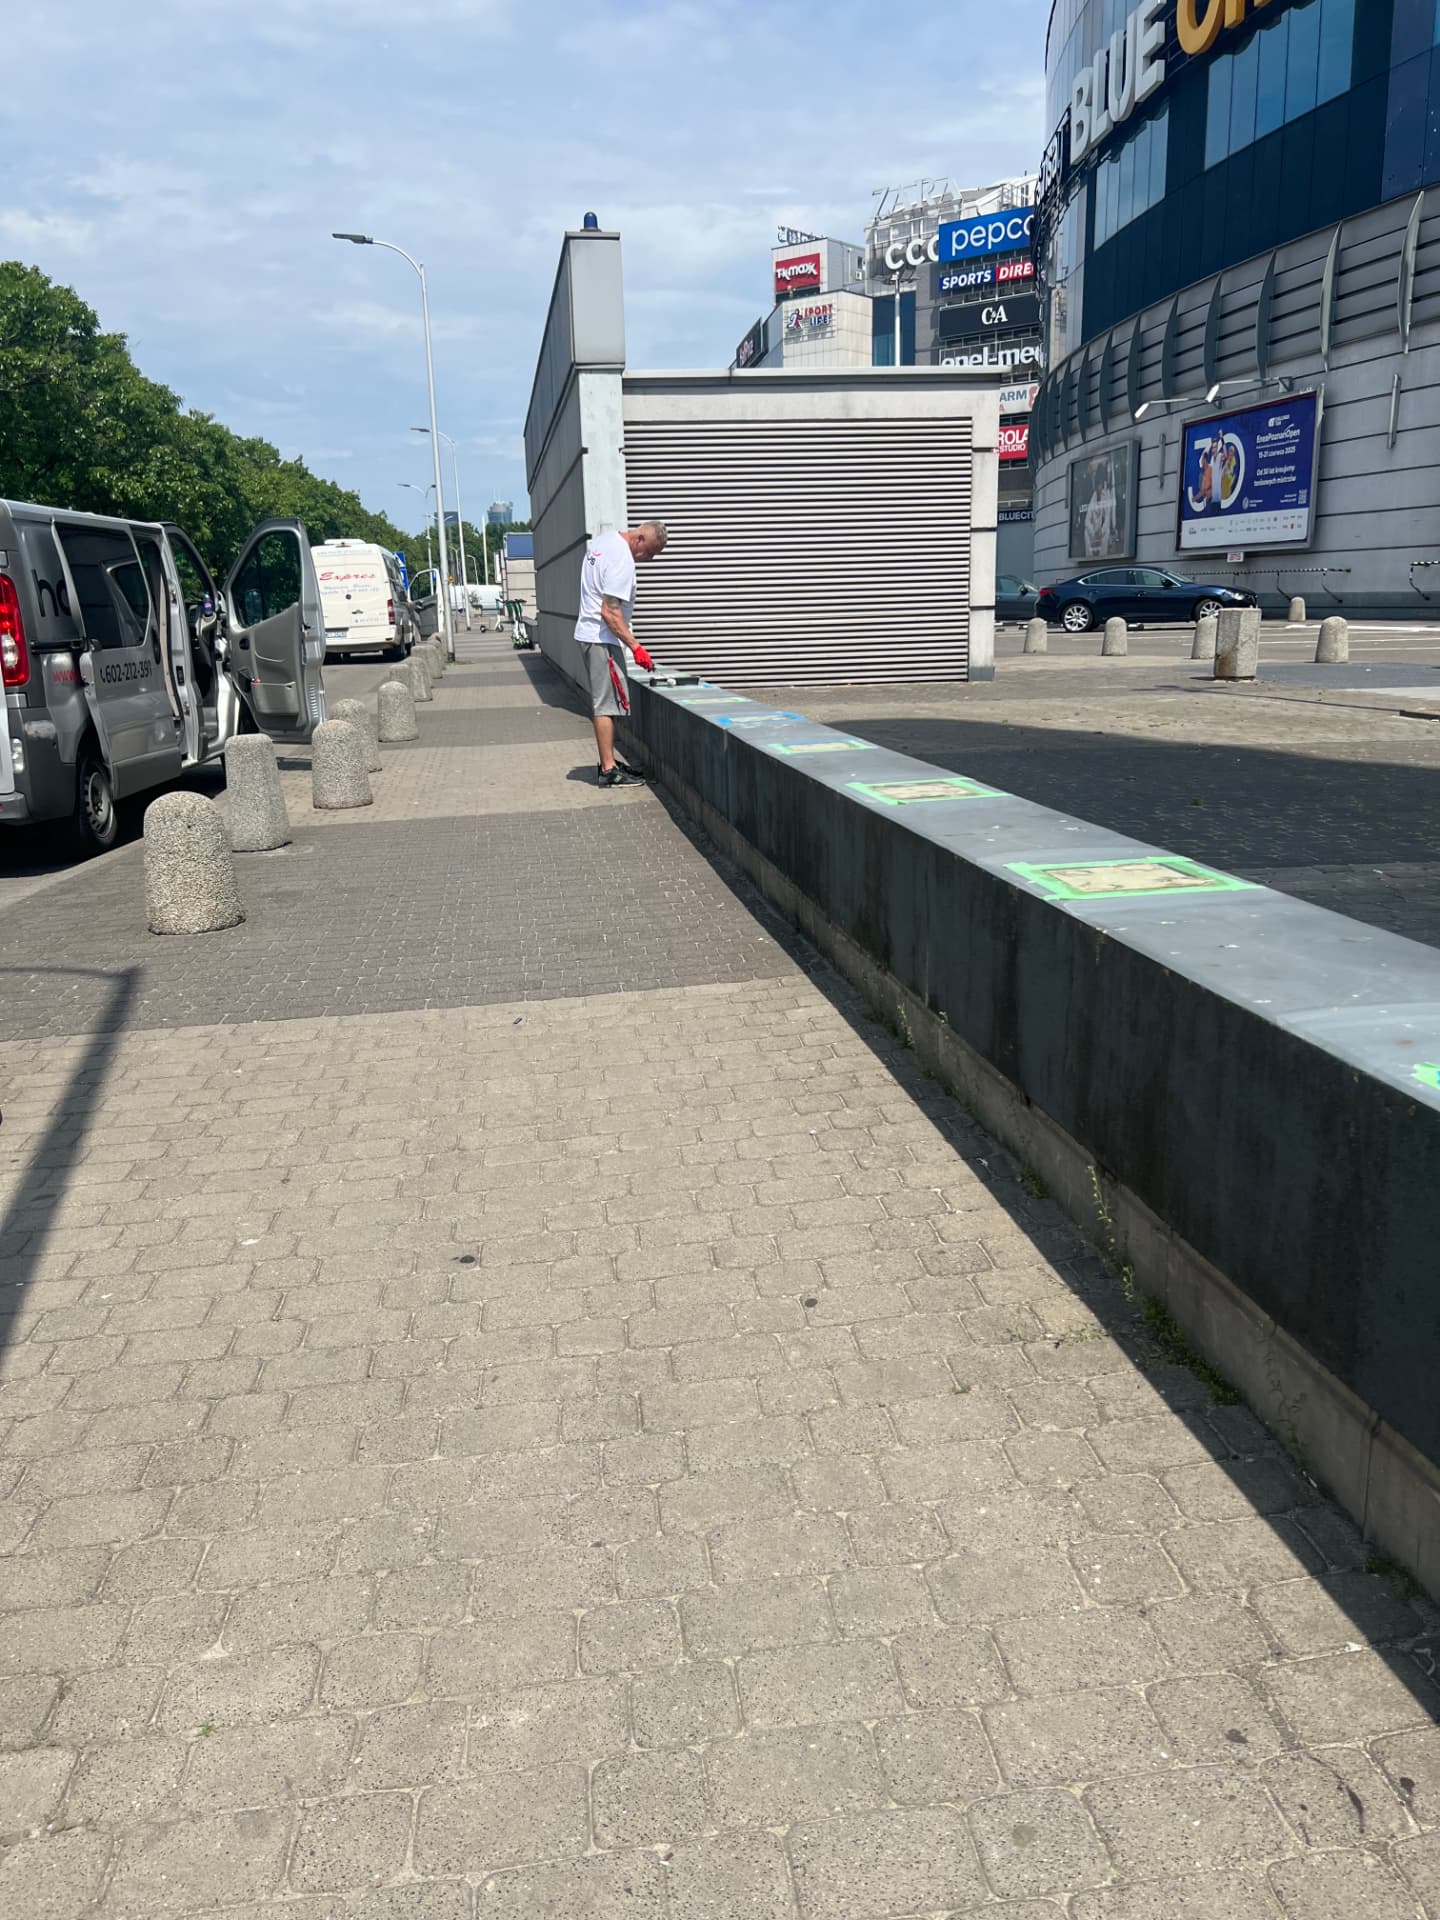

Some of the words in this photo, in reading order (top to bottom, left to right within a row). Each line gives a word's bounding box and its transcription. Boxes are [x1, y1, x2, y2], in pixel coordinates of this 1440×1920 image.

[1070, 0, 1166, 166] BLUE
[942, 270, 991, 290] SPORTS
[998, 262, 1033, 280] DIRE
[804, 303, 833, 317] SPORT
[981, 305, 1008, 325] C&A
[1000, 389, 1027, 401] ARM
[998, 429, 1029, 445] ROLA
[1000, 444, 1026, 453] STUDIO
[105, 660, 152, 684] 602-212-391
